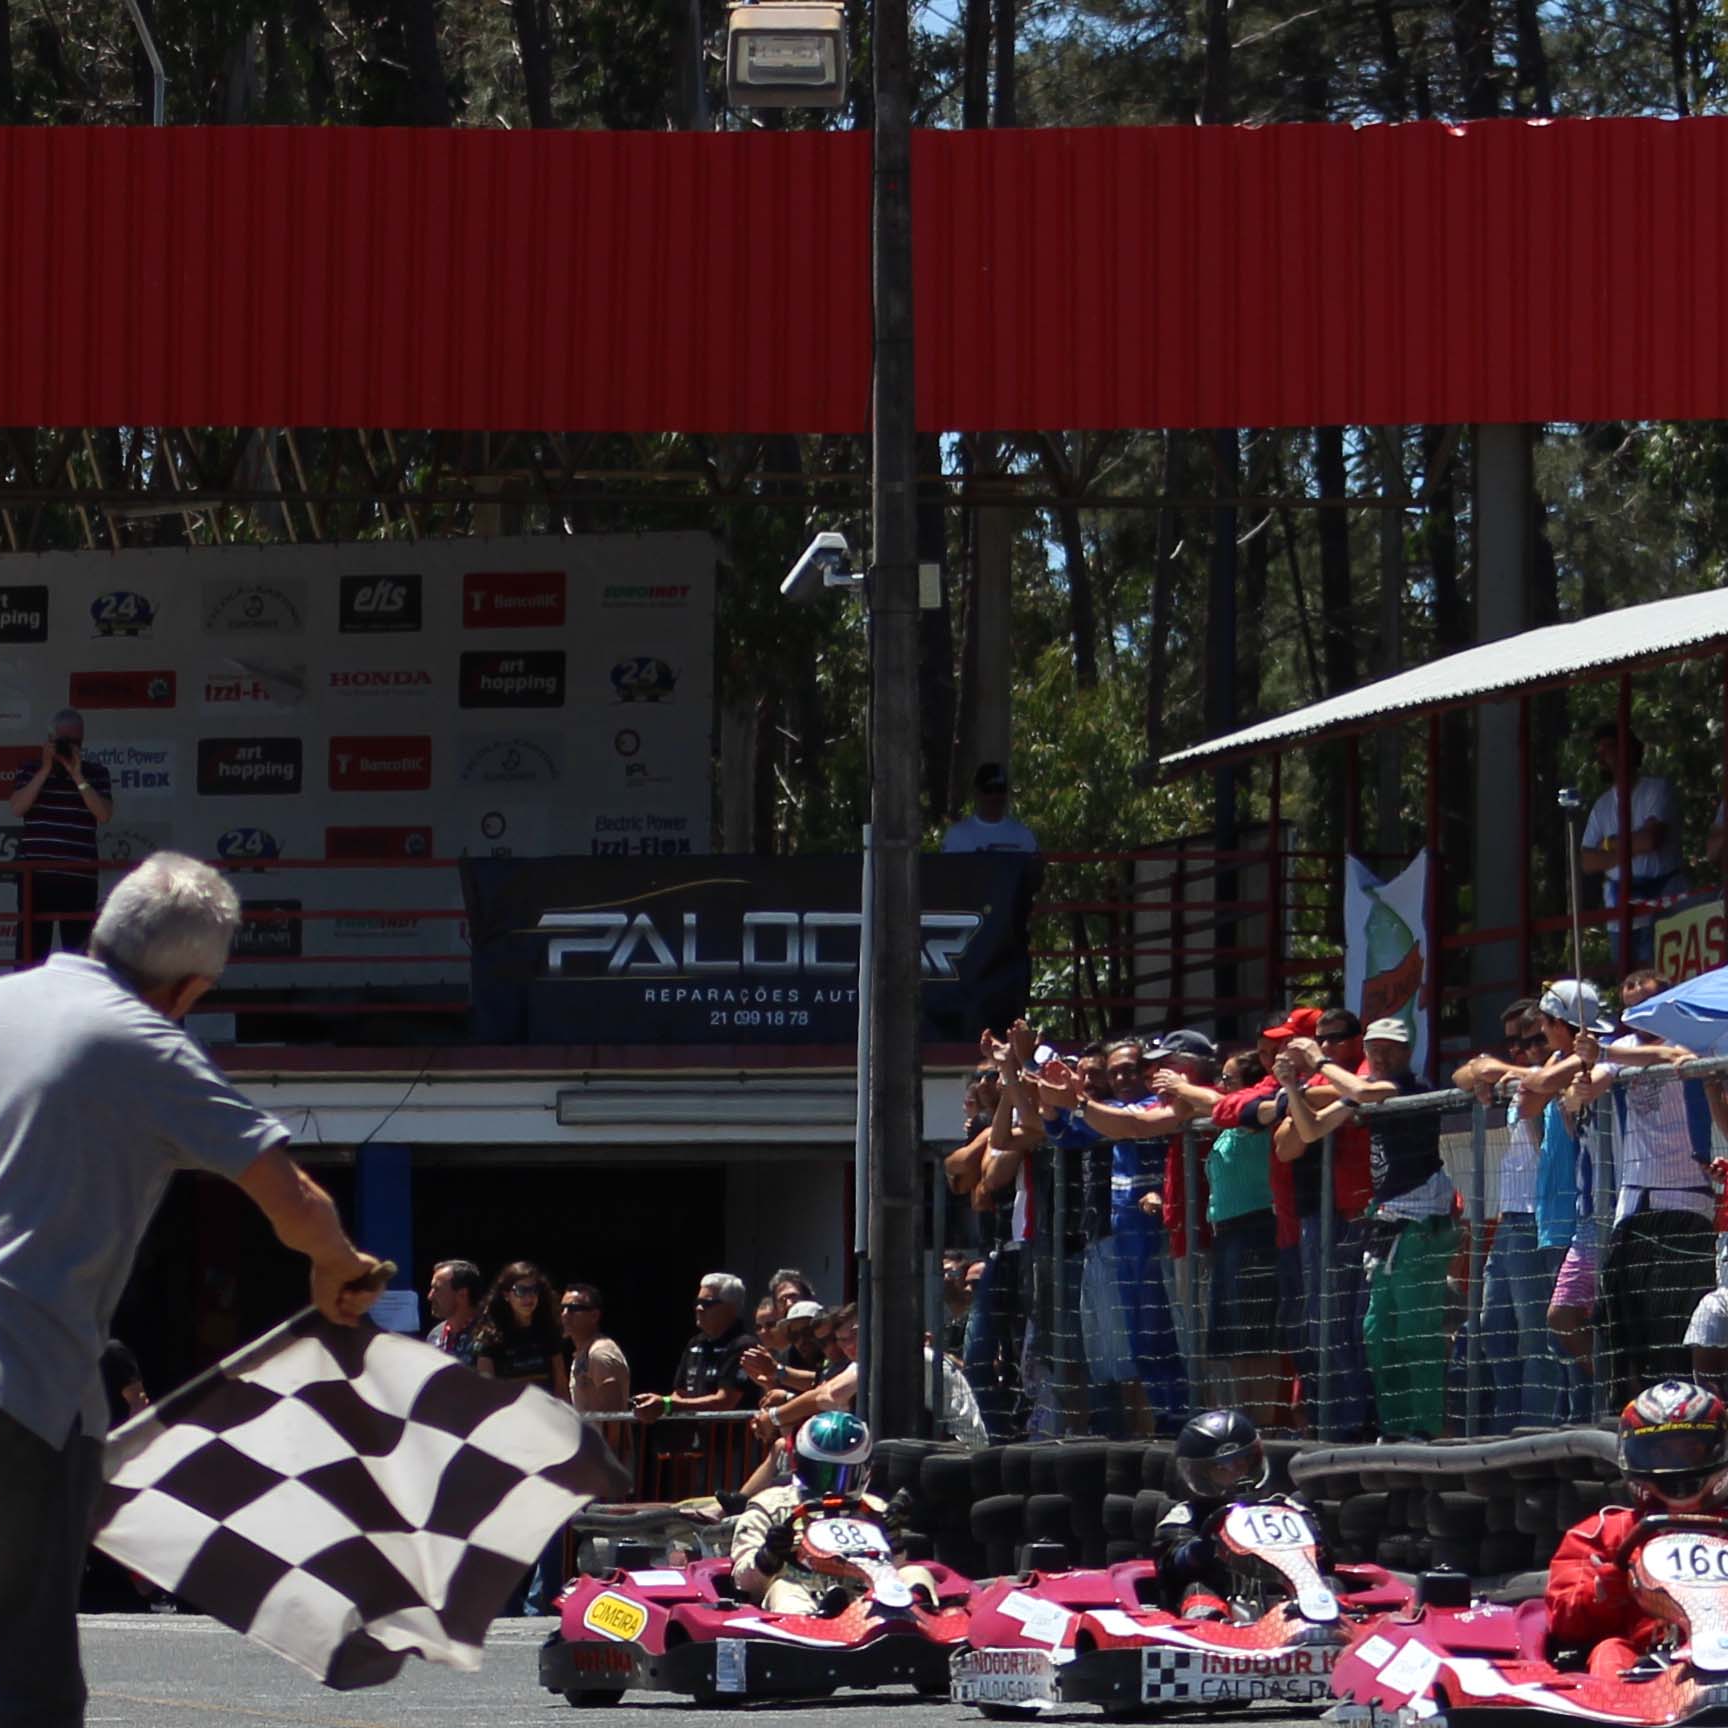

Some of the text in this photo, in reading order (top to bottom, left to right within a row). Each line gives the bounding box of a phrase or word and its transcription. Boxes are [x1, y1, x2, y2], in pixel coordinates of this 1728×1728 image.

[99, 595, 140, 620] 24
[498, 657, 526, 673] art
[620, 661, 659, 684] 24
[328, 671, 433, 687] HONDA
[480, 674, 559, 695] hopping
[126, 748, 168, 764] Power
[235, 745, 263, 760] art
[111, 770, 171, 788] -Flex
[218, 760, 295, 781] hopping
[646, 815, 688, 831] Power
[225, 830, 264, 857] 24
[644, 985, 858, 1006] REPARAÇÕES AUT
[710, 1009, 809, 1026] 21 099 18 78
[830, 1524, 868, 1545] 88
[1243, 1513, 1303, 1543] 150
[591, 1601, 640, 1634] CIMEIRA
[1201, 1650, 1312, 1678] INDOOR
[1200, 1678, 1299, 1701] CALDAS
